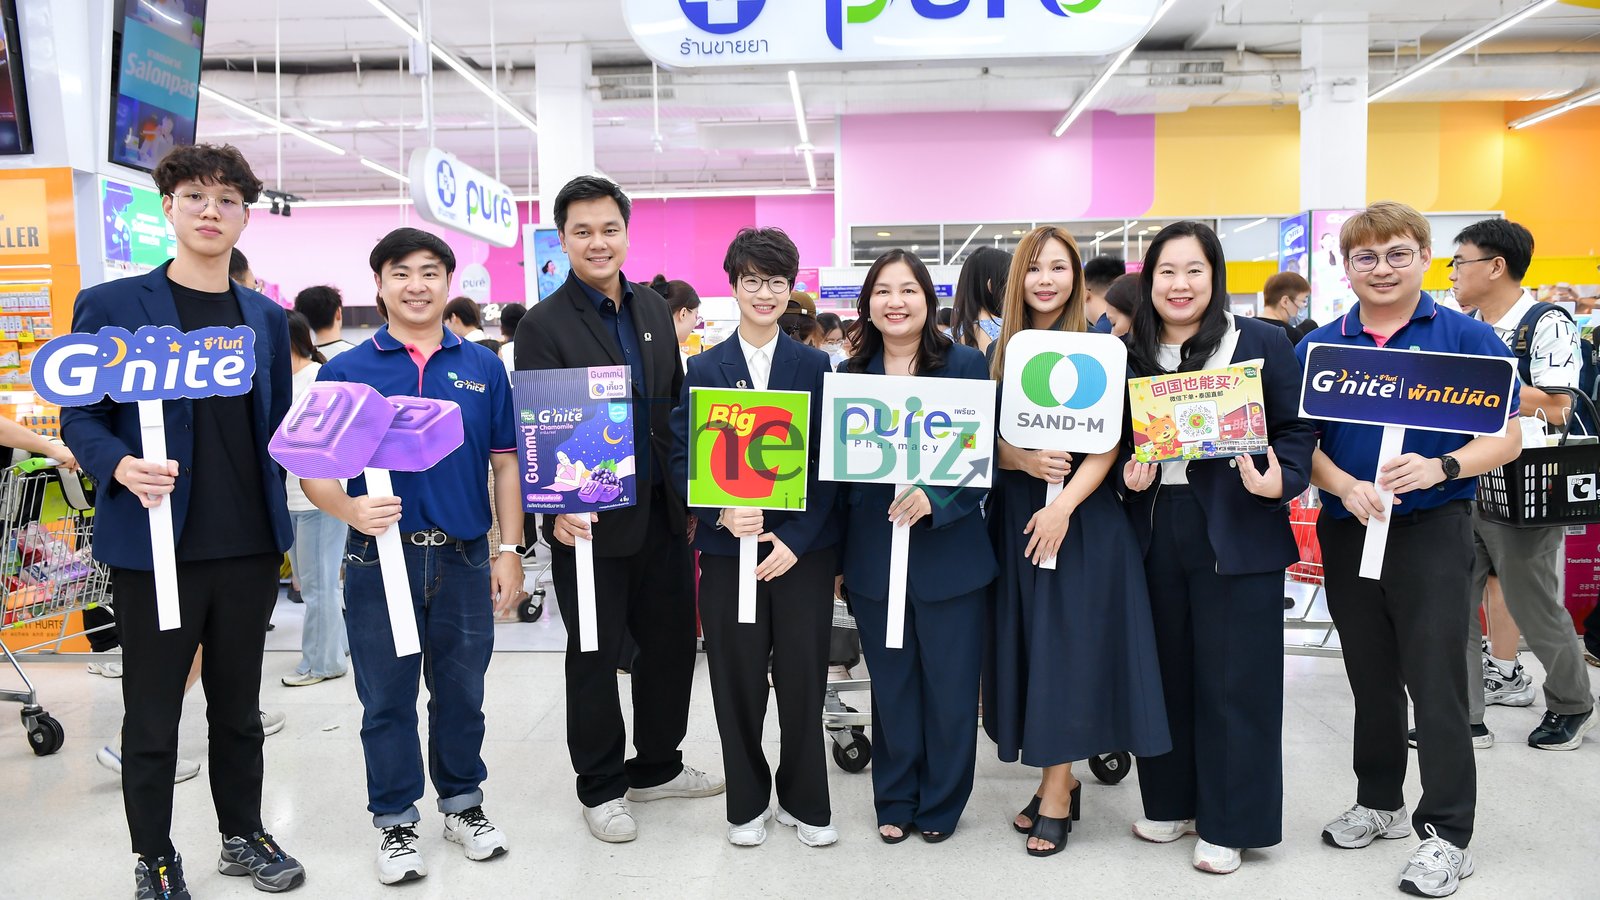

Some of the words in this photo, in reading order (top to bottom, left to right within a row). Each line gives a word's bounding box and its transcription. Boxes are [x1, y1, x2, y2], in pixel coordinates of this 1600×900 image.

[680, 37, 769, 56] ร้านขายยา
[125, 52, 197, 99] Salonpas
[466, 180, 512, 228] pure
[590, 368, 623, 379] Gummy
[1151, 375, 1240, 398] 回国也能买!
[1408, 383, 1501, 408] พักไม่ผิด
[706, 403, 757, 437] Big
[840, 406, 952, 446] pure
[1017, 412, 1104, 433] SAND-M
[522, 425, 539, 484] Gummy
[710, 405, 793, 499] C
[854, 439, 939, 453] Pharmacy
